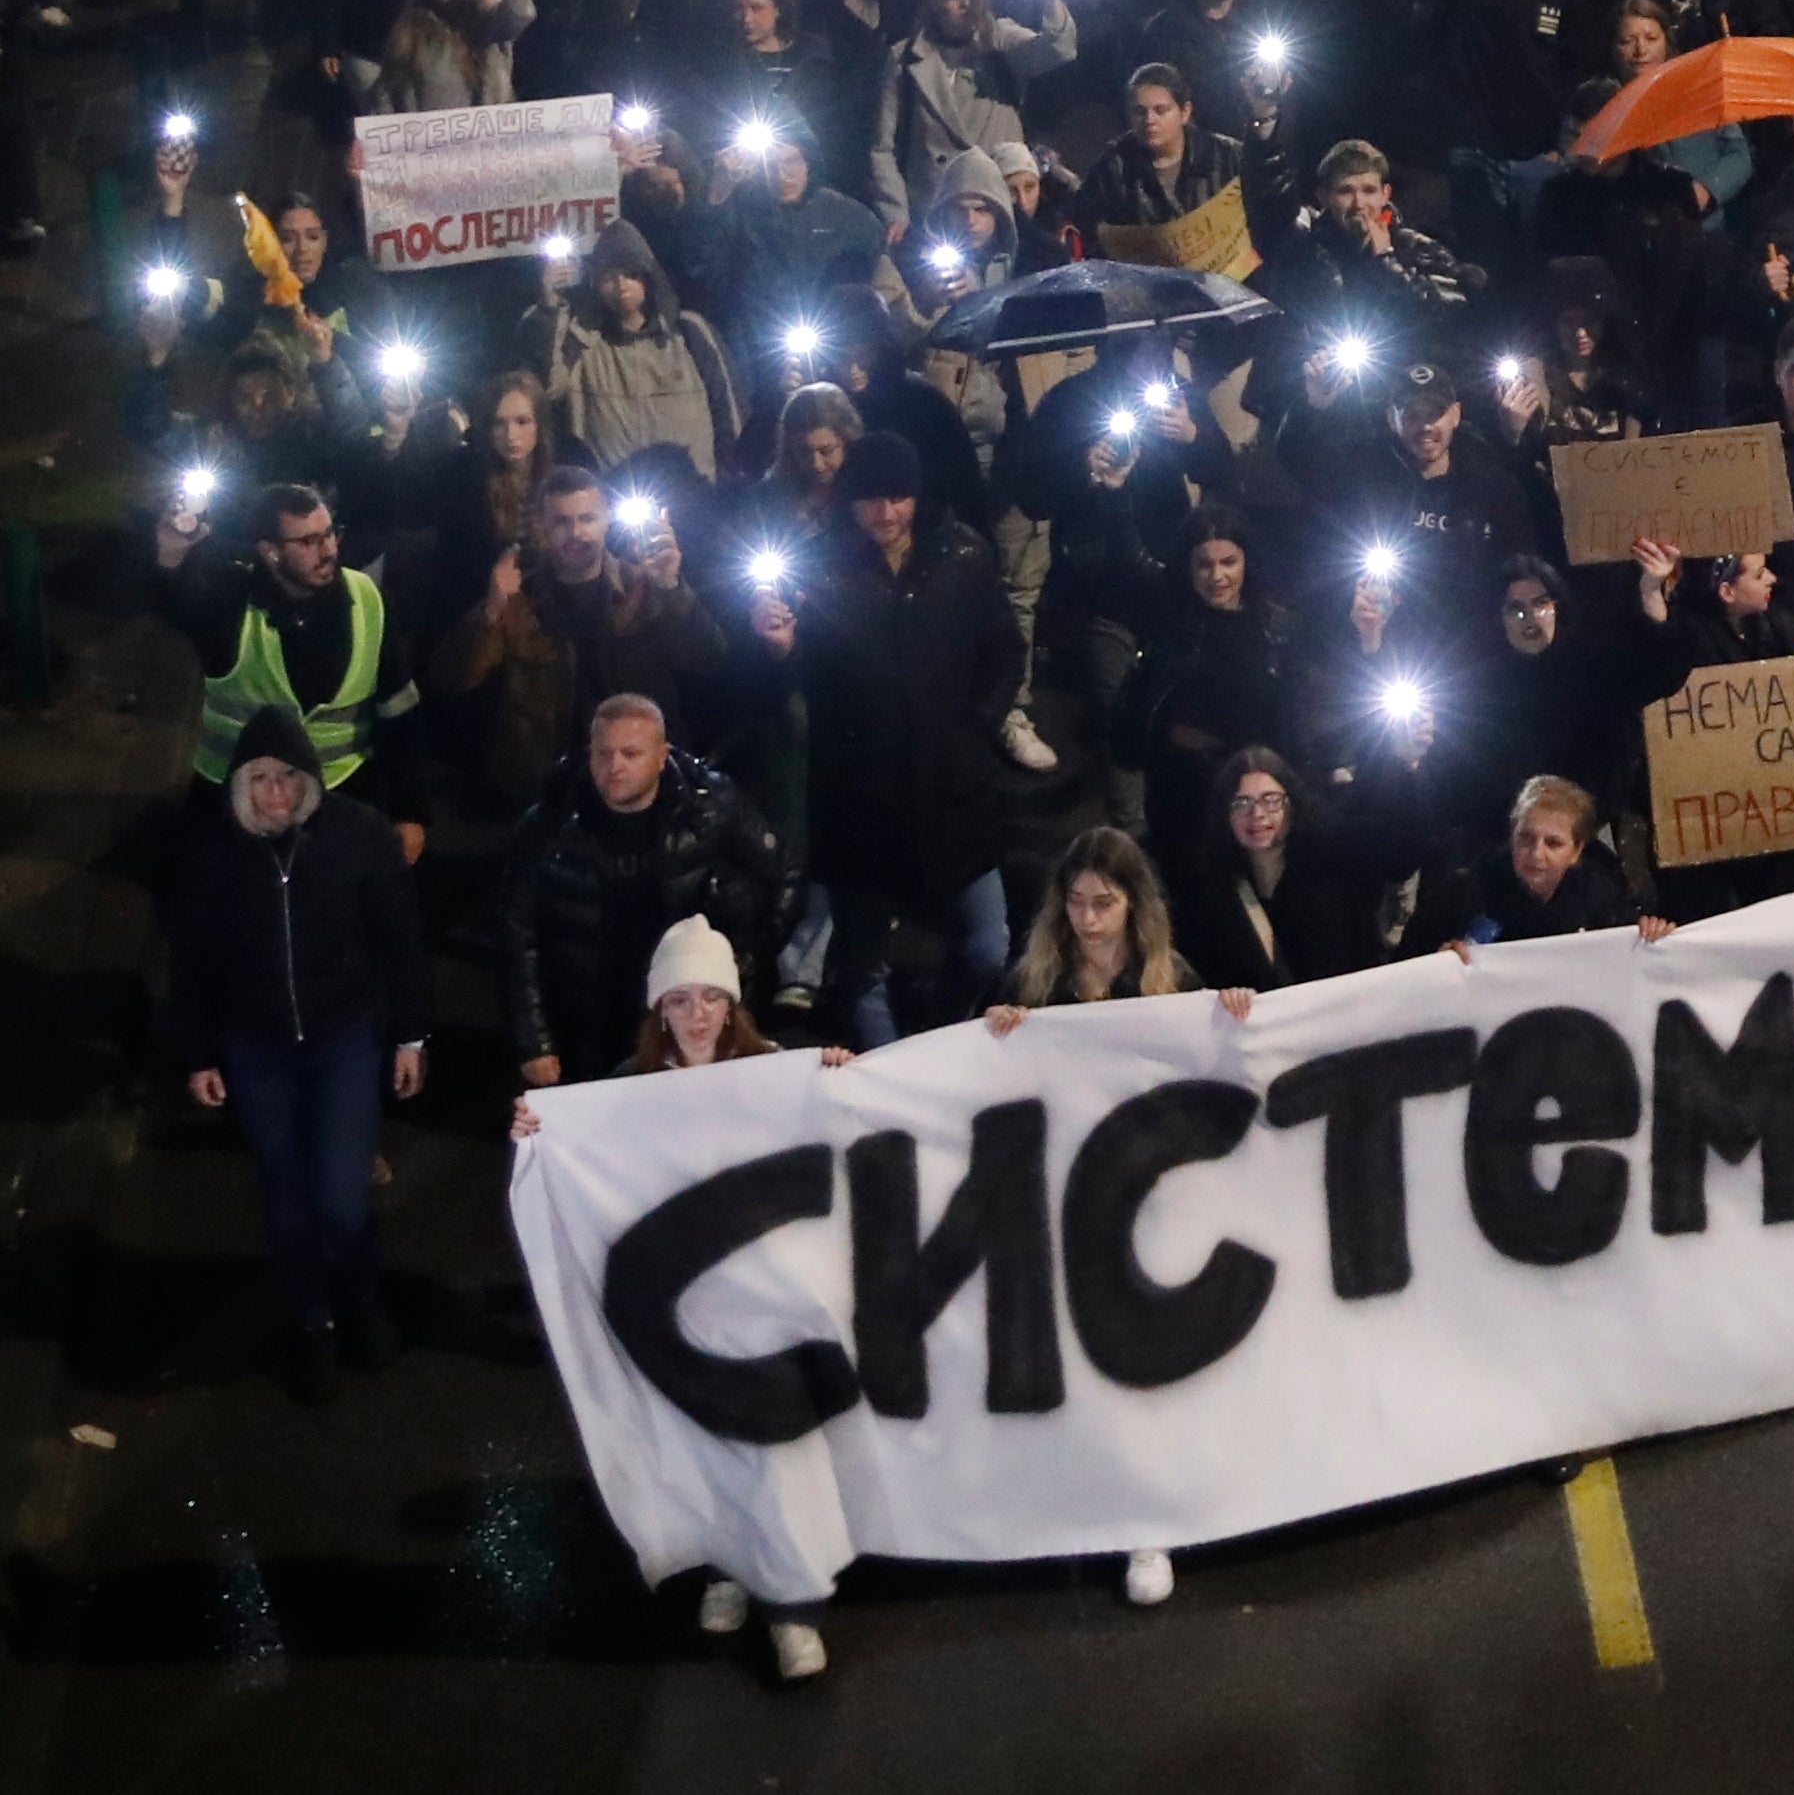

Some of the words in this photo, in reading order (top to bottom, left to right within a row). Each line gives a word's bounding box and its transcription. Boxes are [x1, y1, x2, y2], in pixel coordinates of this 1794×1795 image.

[365, 107, 545, 155] ТРЕБАШЕ
[371, 196, 617, 264] ПОСЛЕДНИТЕ
[1583, 440, 1761, 474] СИСТЕМОТ
[1662, 674, 1793, 740] НЕМА
